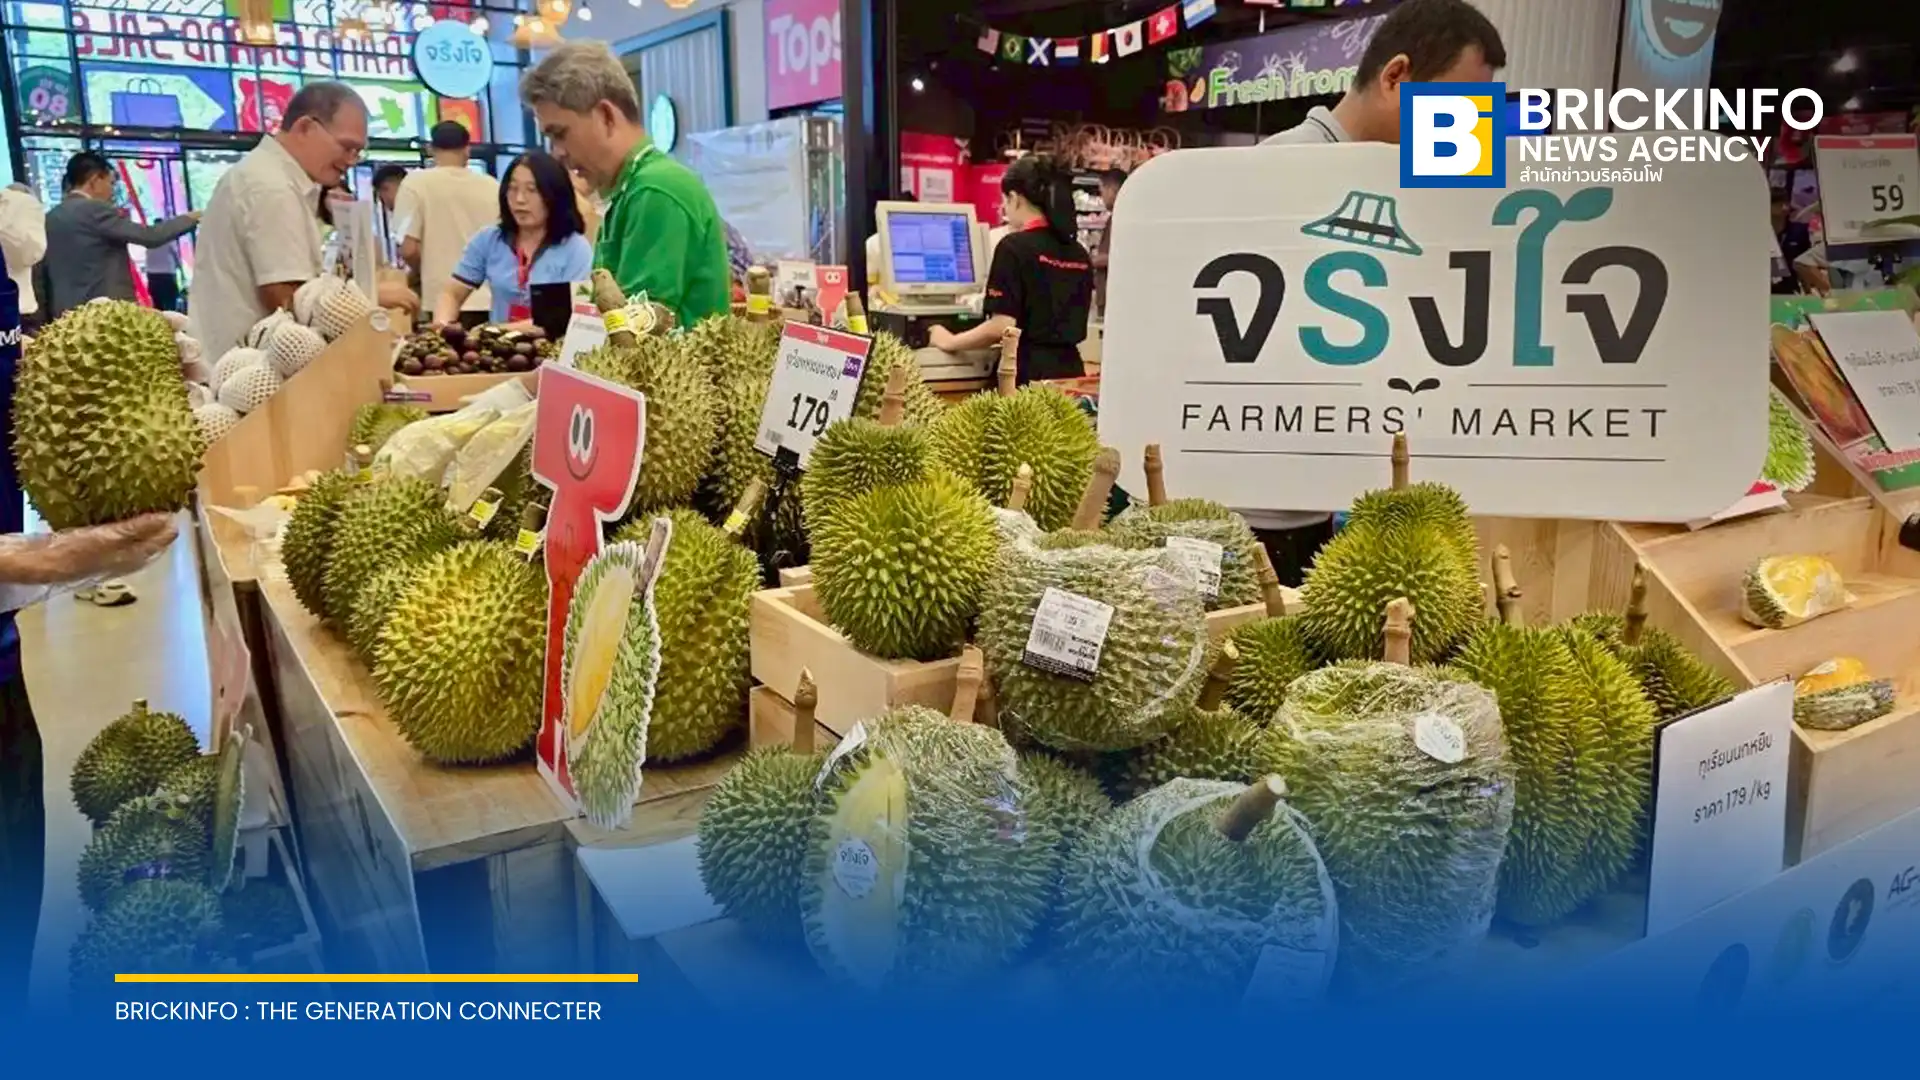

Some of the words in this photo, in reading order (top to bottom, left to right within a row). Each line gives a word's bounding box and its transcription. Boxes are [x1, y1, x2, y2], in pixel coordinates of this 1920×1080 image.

[1208, 66, 1286, 108] Fresh
[1872, 185, 1904, 212] 59
[787, 393, 830, 437] 179
[1181, 404, 1423, 435] FARMERS'
[1452, 408, 1668, 438] MARKET
[1694, 799, 1723, 823] ราคา
[1726, 786, 1747, 811] 179
